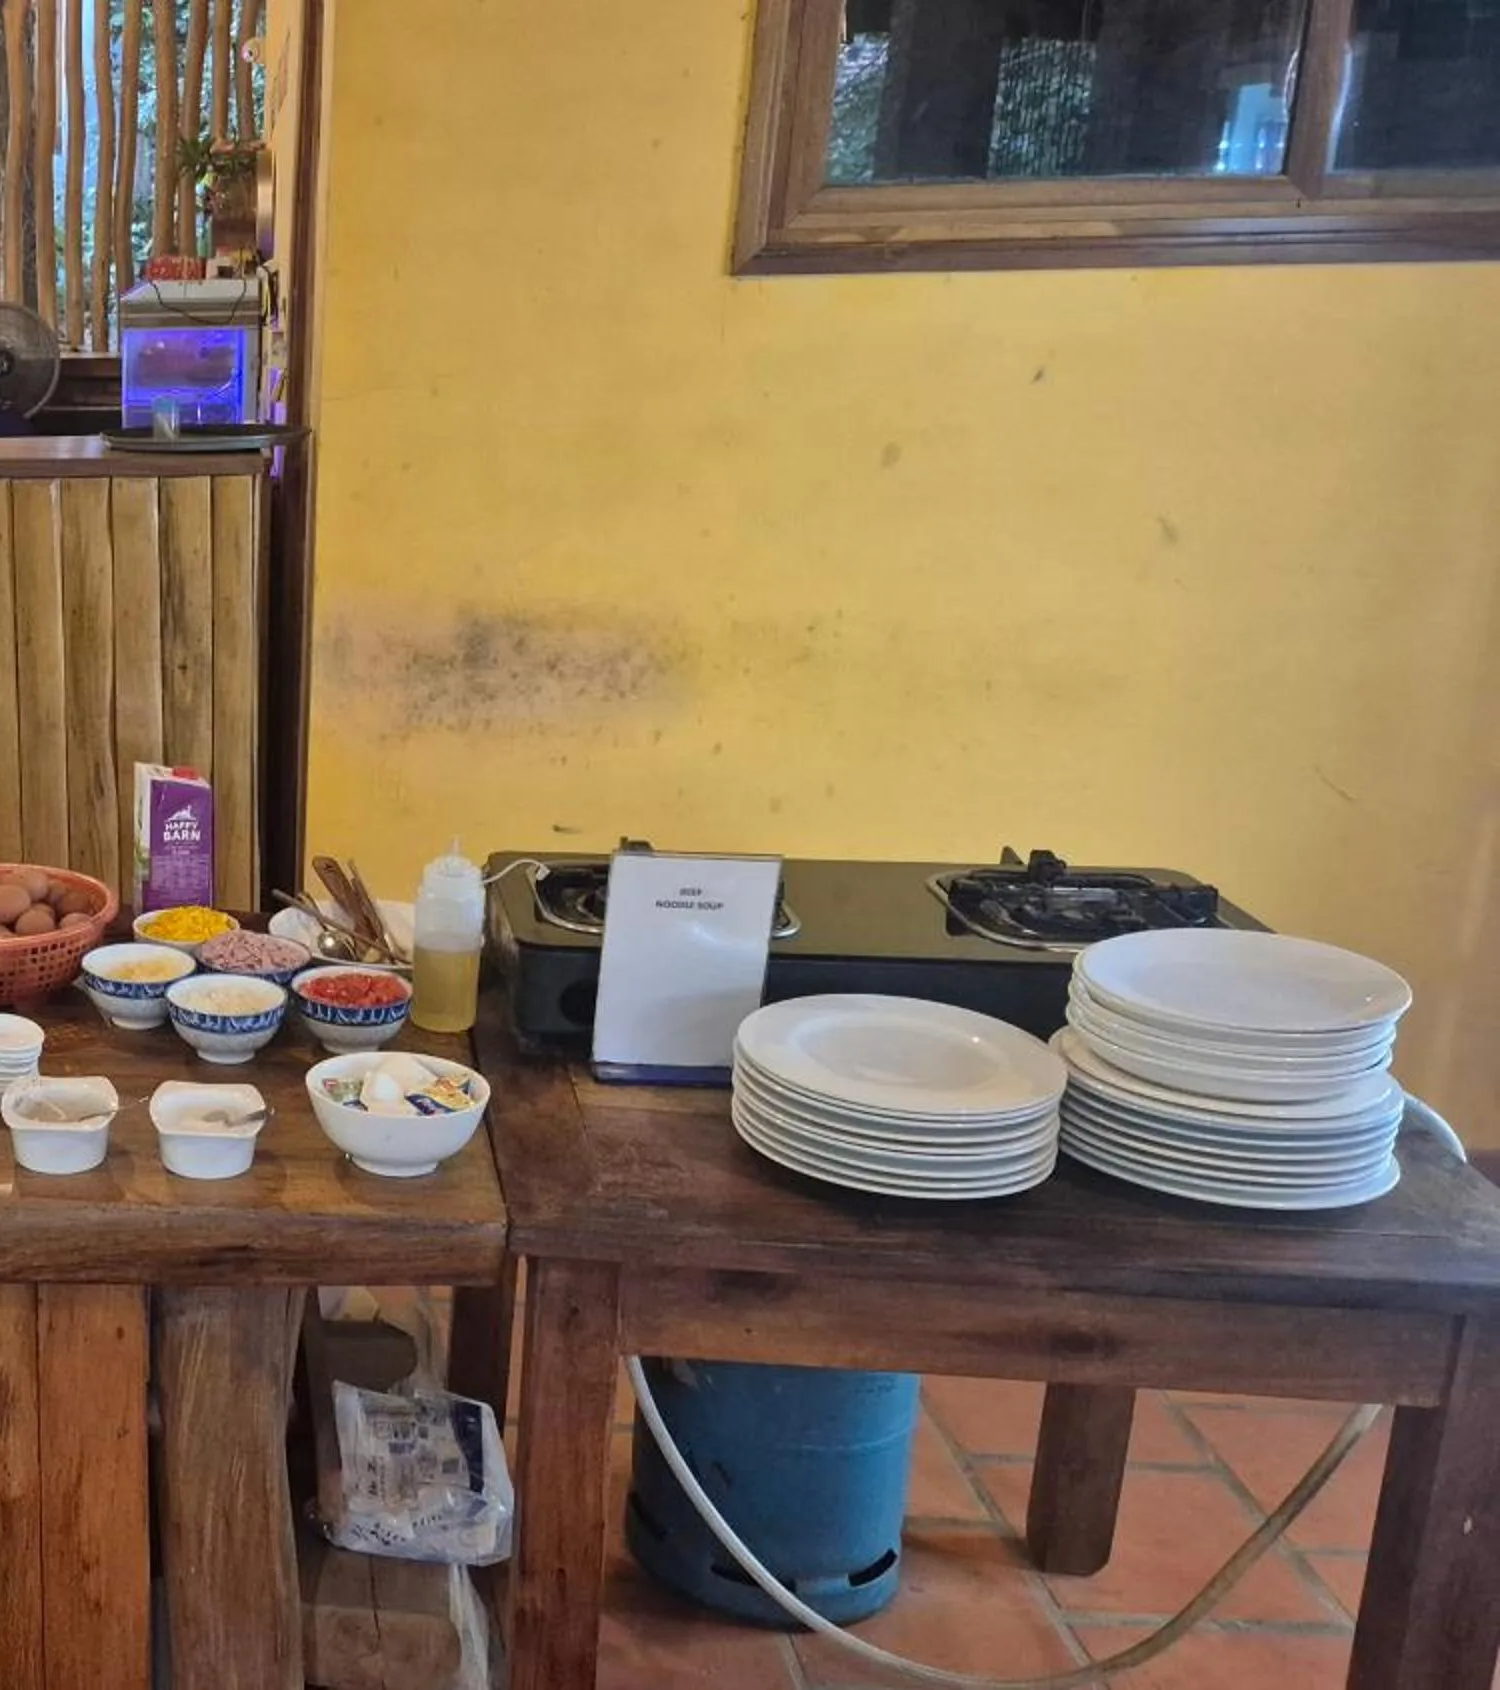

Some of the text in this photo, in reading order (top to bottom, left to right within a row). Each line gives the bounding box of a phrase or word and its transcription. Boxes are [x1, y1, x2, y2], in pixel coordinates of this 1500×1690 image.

[165, 821, 199, 832] HAPPY
[163, 831, 201, 842] BARN
[697, 901, 725, 910] SOUP
